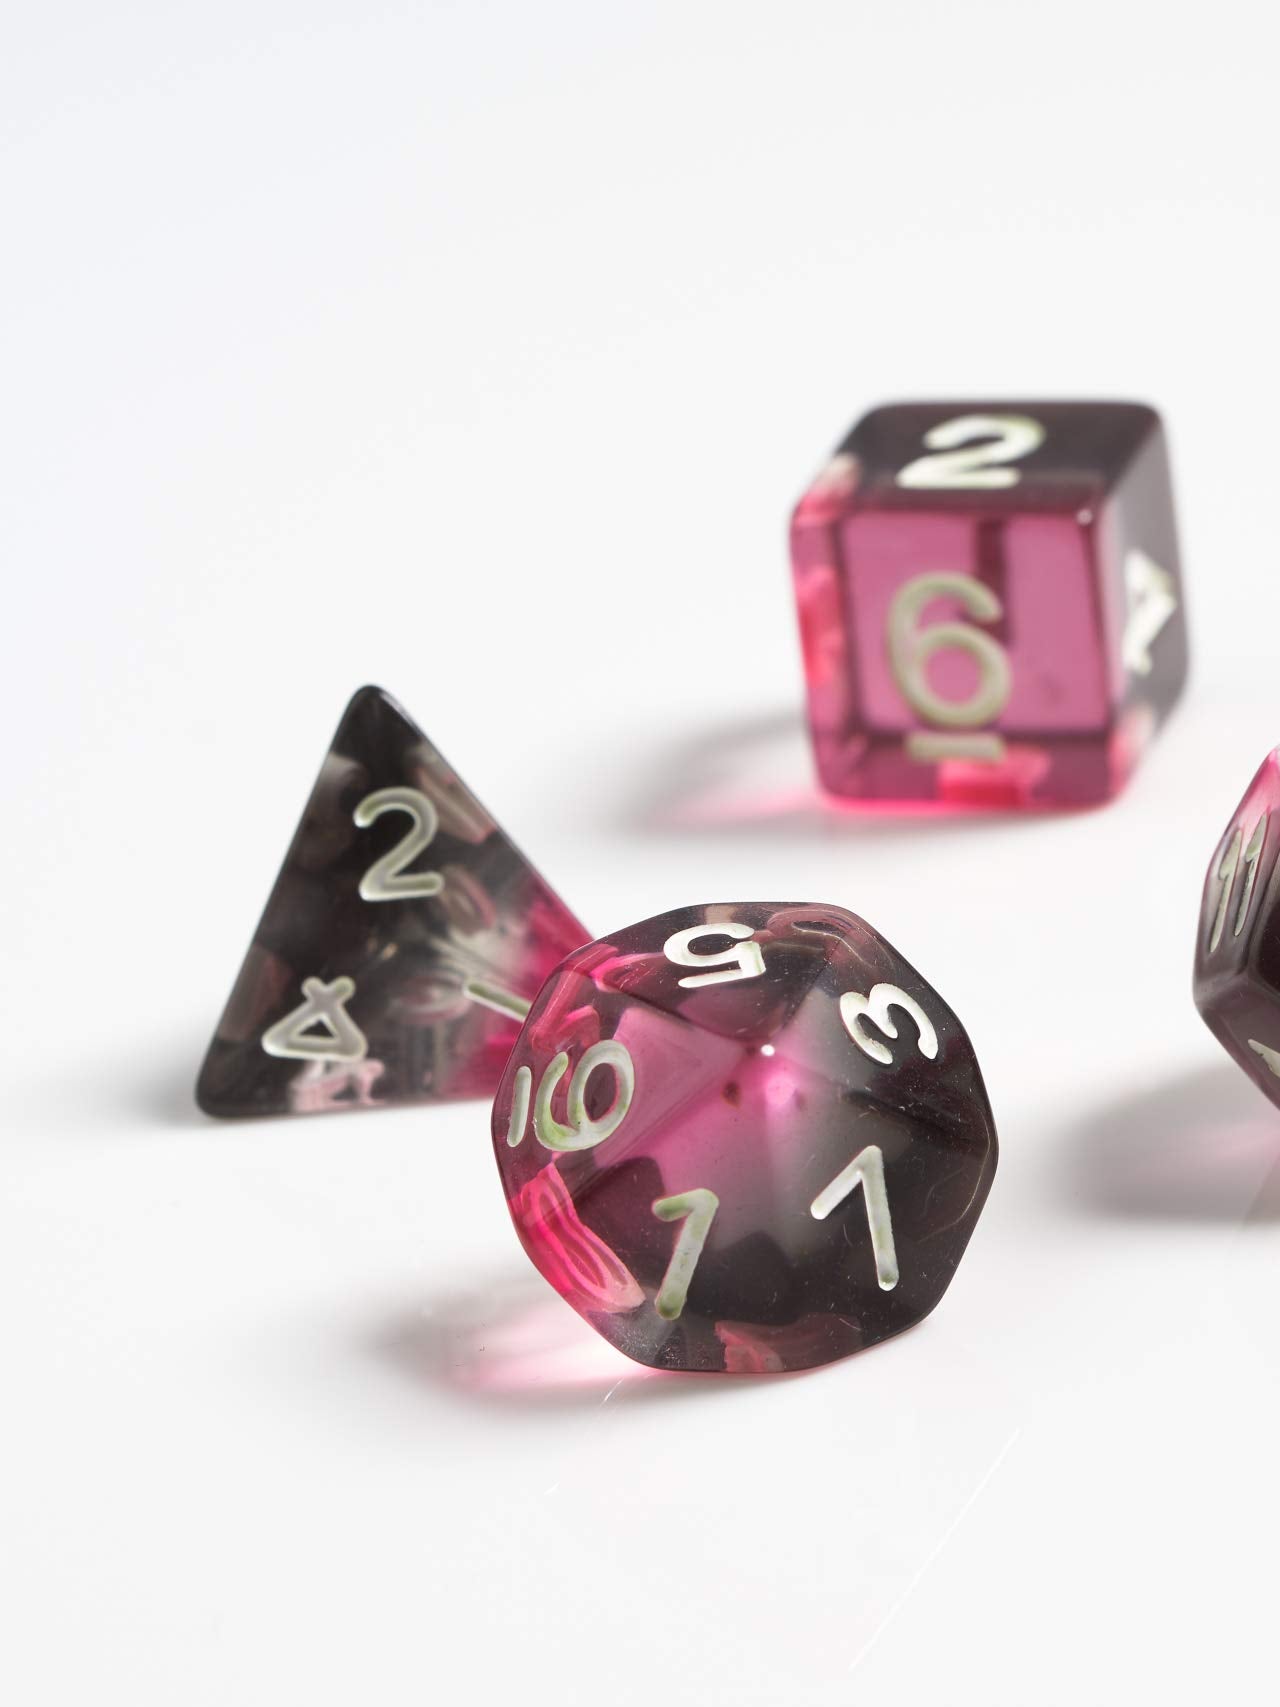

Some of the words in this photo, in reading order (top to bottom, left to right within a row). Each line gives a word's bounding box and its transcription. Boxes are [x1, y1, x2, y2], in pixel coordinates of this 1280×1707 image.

[896, 414, 1045, 489] 2
[353, 786, 444, 902] 2
[1209, 811, 1268, 954] 11
[663, 922, 767, 989] 5
[262, 975, 369, 1062] 4
[839, 982, 940, 1065] 3
